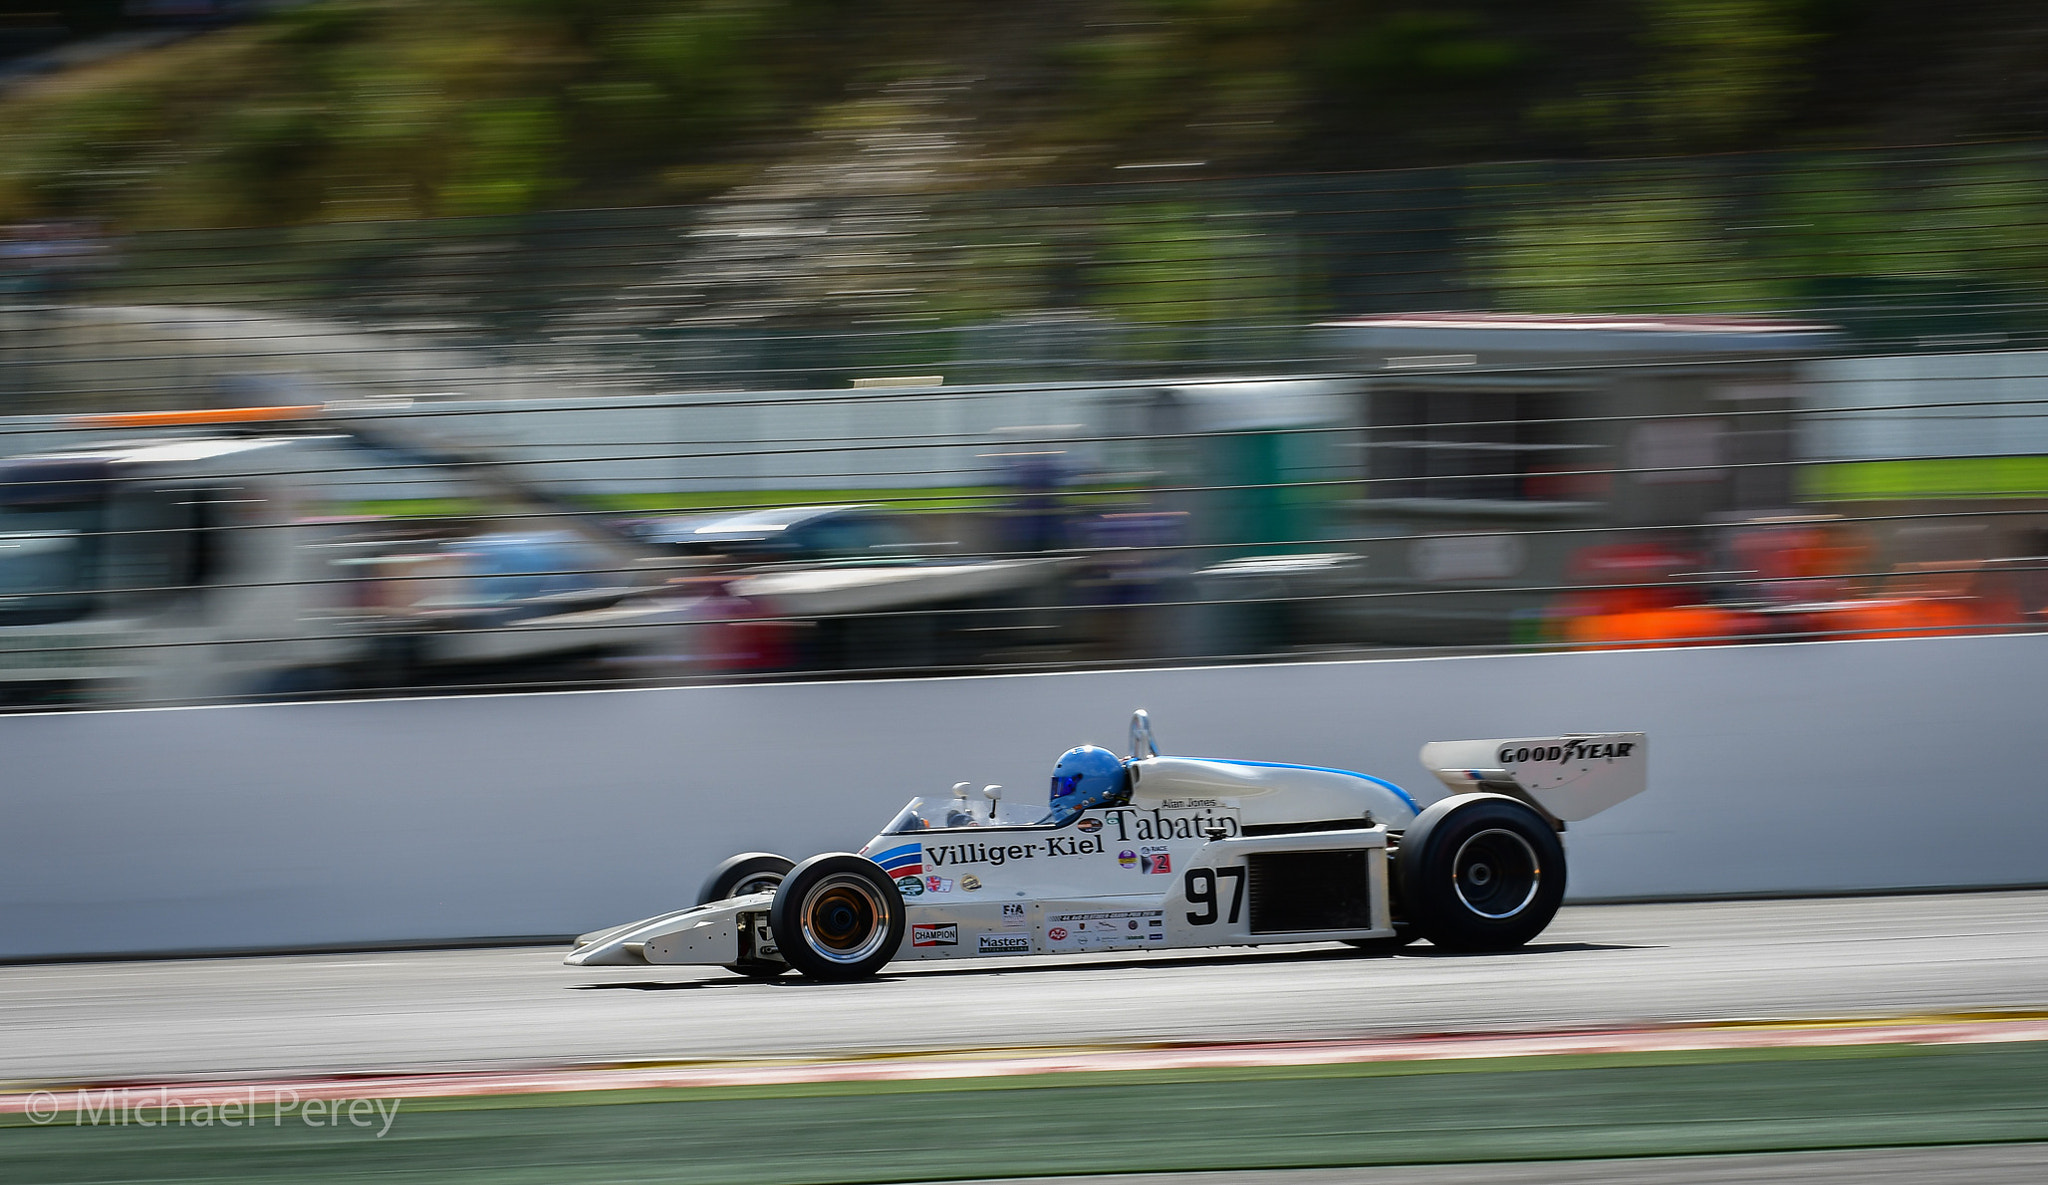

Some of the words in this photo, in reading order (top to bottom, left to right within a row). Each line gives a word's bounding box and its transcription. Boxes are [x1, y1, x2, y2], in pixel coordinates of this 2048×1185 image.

[1500, 739, 1637, 764] GOODYEAR
[1162, 799, 1185, 808] Alan
[1186, 798, 1216, 807] Jones
[926, 835, 1106, 866] Villiger-Kiel
[1156, 855, 1168, 870] 2
[1185, 866, 1246, 926] 97
[915, 931, 955, 940] CHAMPION
[979, 937, 1028, 947] Masters
